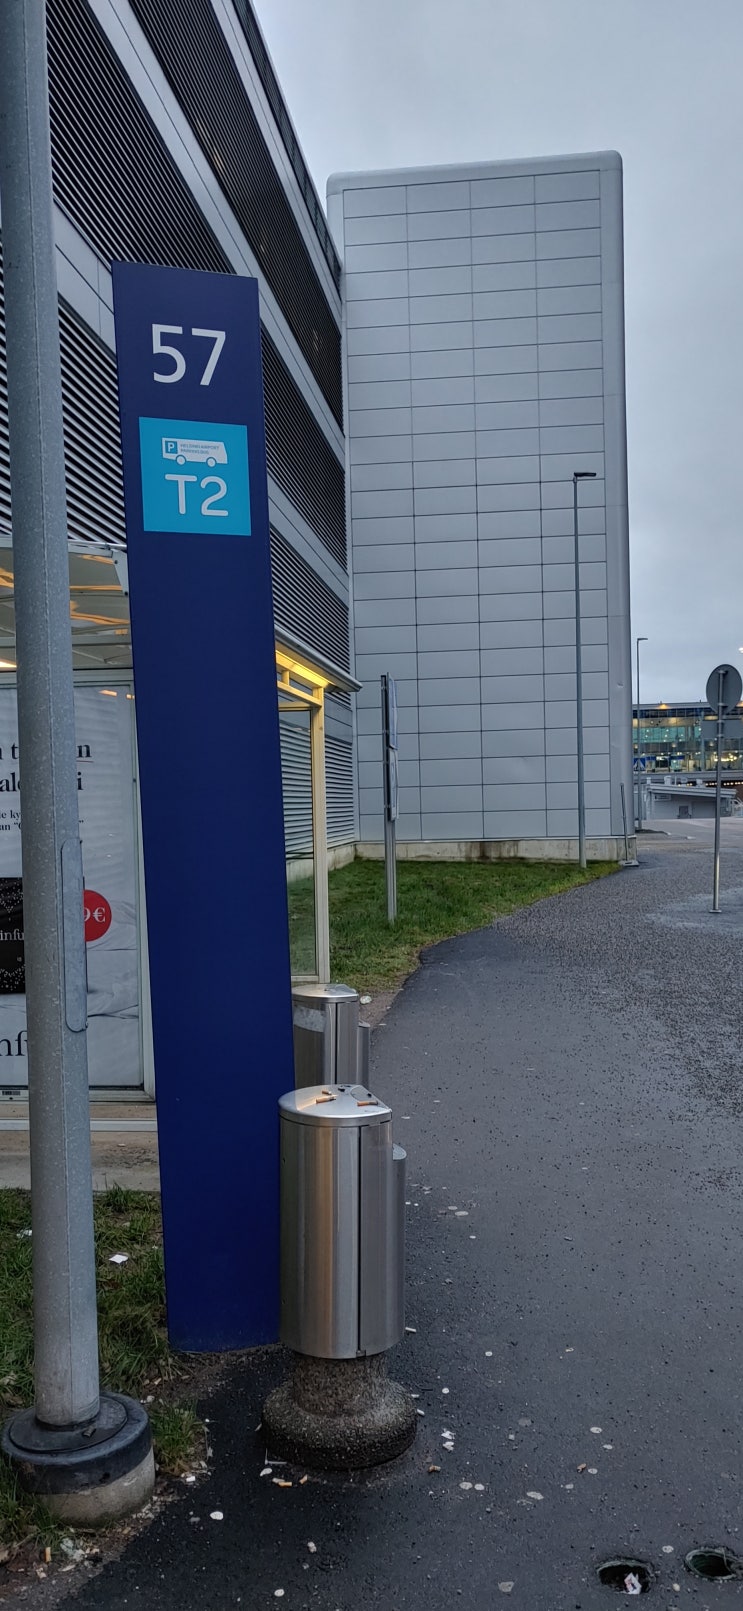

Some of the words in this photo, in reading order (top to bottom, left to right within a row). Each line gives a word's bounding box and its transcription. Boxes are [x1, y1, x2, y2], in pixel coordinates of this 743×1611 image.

[152, 323, 226, 386] 57
[167, 442, 175, 453] P
[165, 473, 229, 517] T2
